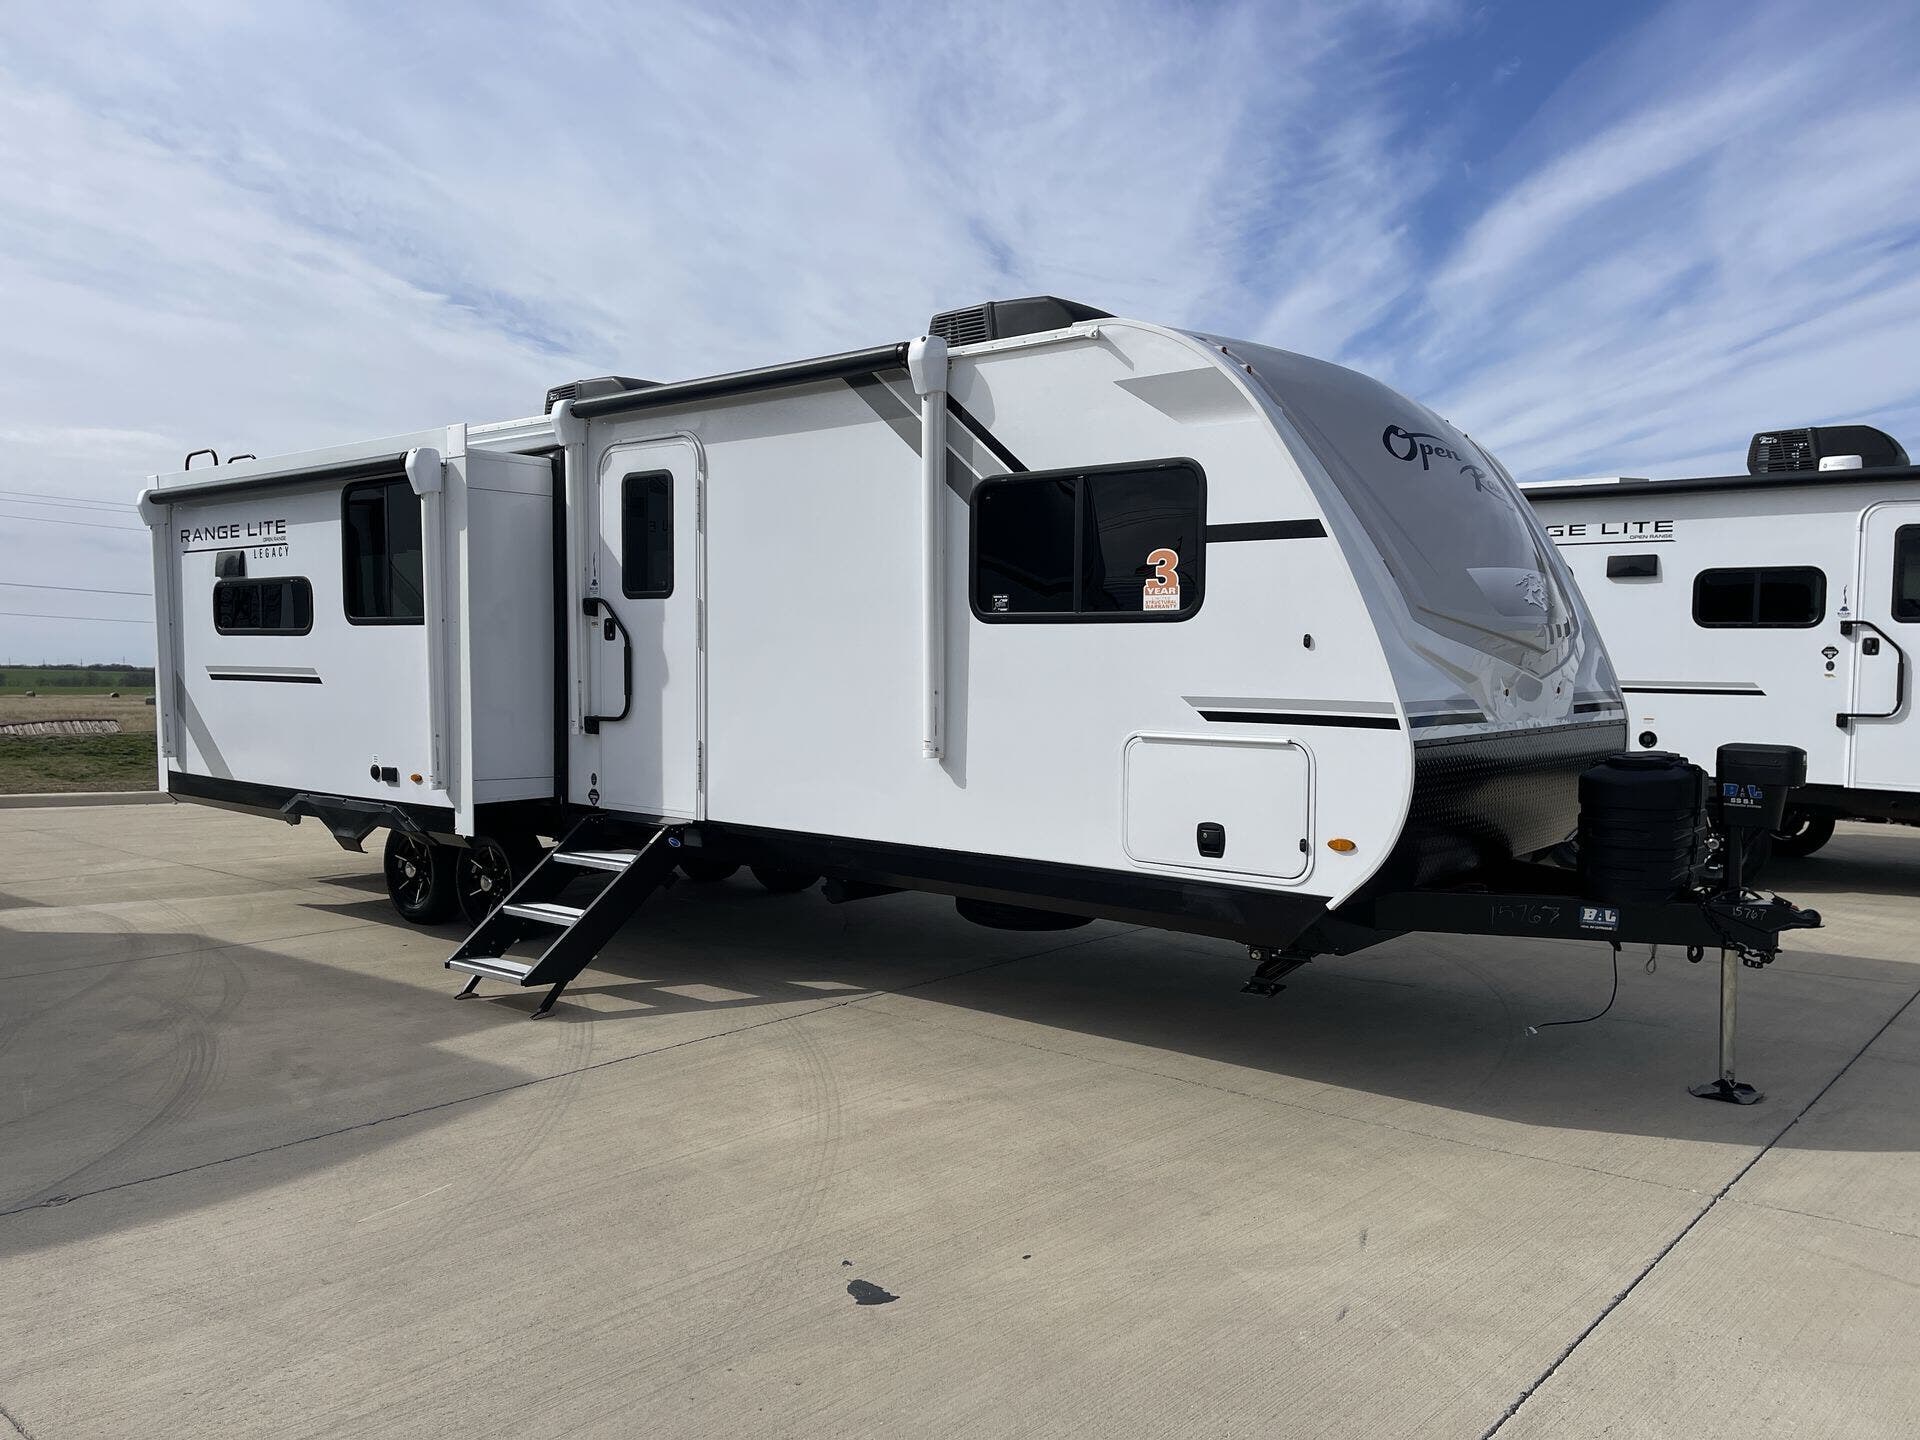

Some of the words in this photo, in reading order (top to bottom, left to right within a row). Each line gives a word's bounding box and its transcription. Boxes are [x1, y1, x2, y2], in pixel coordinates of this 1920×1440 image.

[1383, 424, 1462, 470] Open
[180, 524, 240, 543] RANGE
[247, 519, 286, 537] LITE
[1601, 520, 1674, 535] LITE
[253, 546, 289, 559] LEGACY
[1145, 548, 1179, 587] 3
[1147, 587, 1176, 595] YEAR
[1732, 906, 1767, 920] 15767
